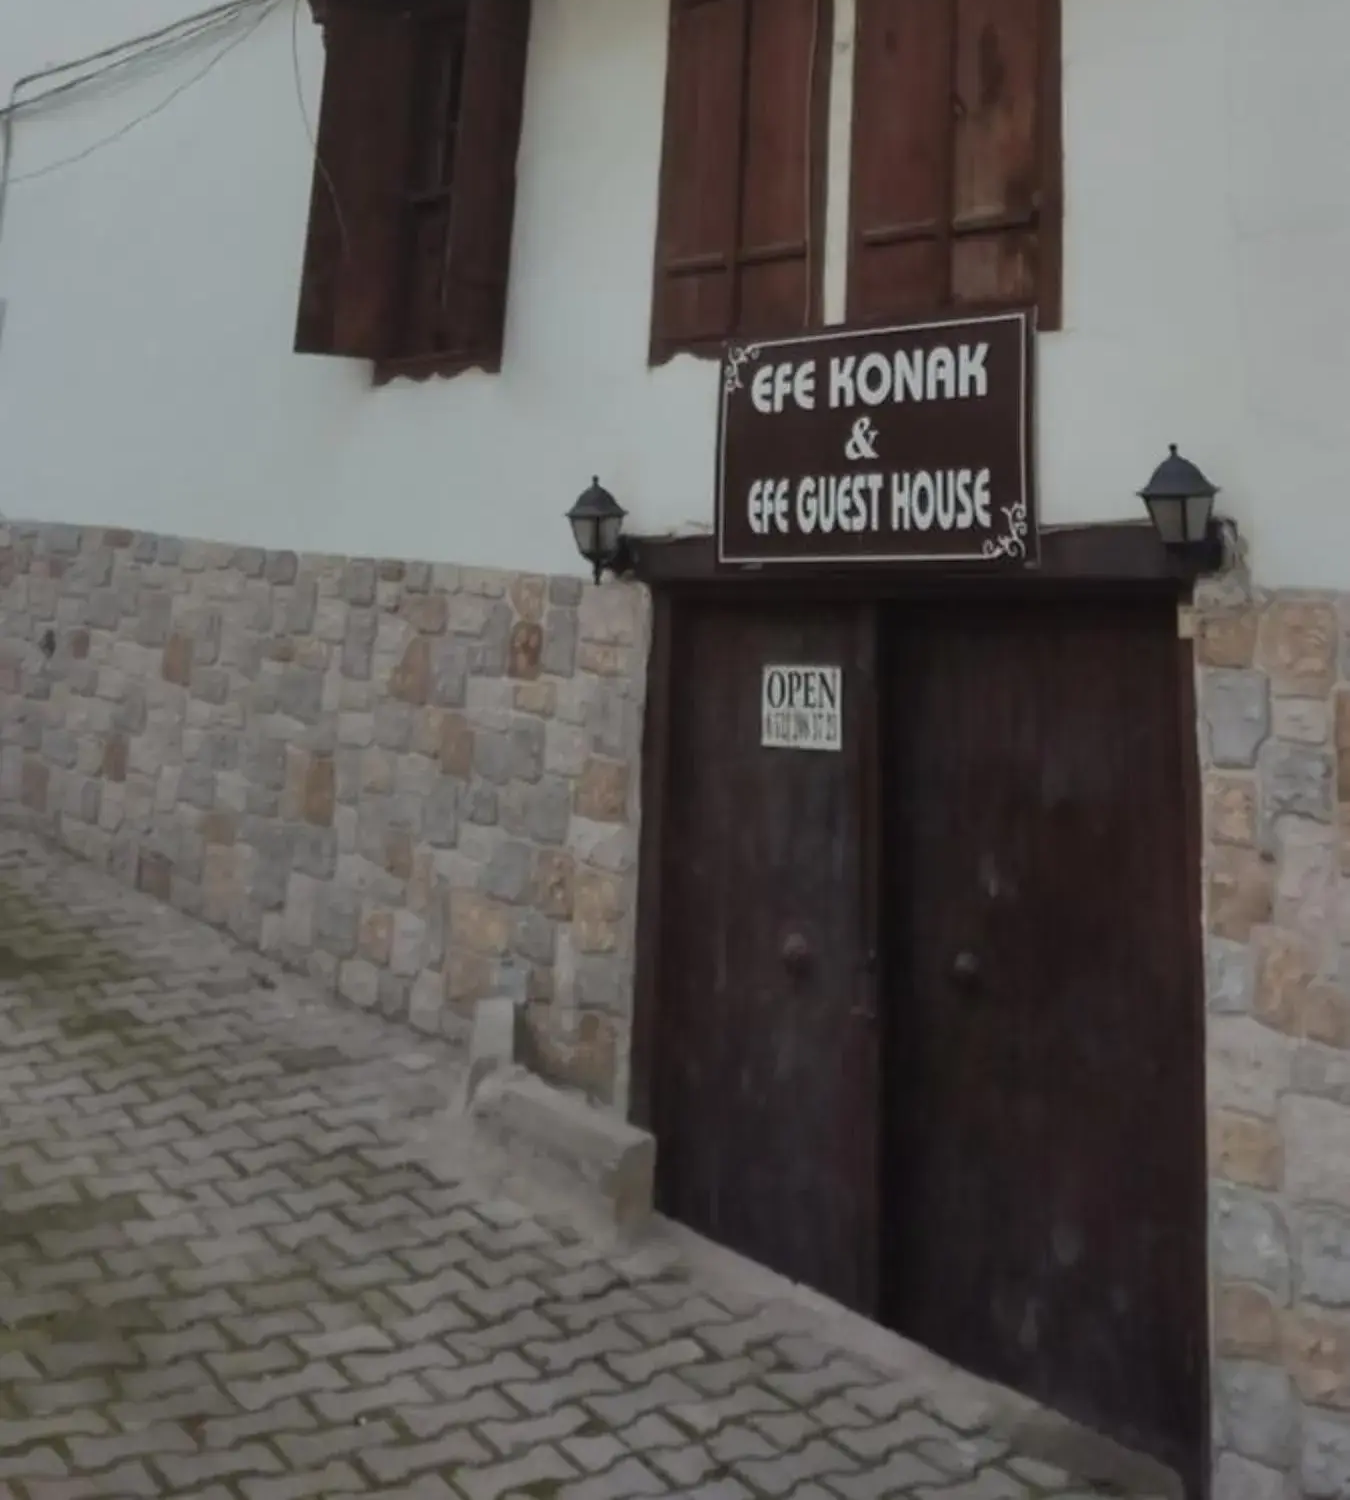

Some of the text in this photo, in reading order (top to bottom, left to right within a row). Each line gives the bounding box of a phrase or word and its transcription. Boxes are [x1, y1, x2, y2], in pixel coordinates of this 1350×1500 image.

[751, 342, 989, 413] EFE KONAK
[845, 416, 879, 460] &
[747, 467, 992, 534] EFE GUEST HOUSE
[767, 671, 837, 709] OPEN
